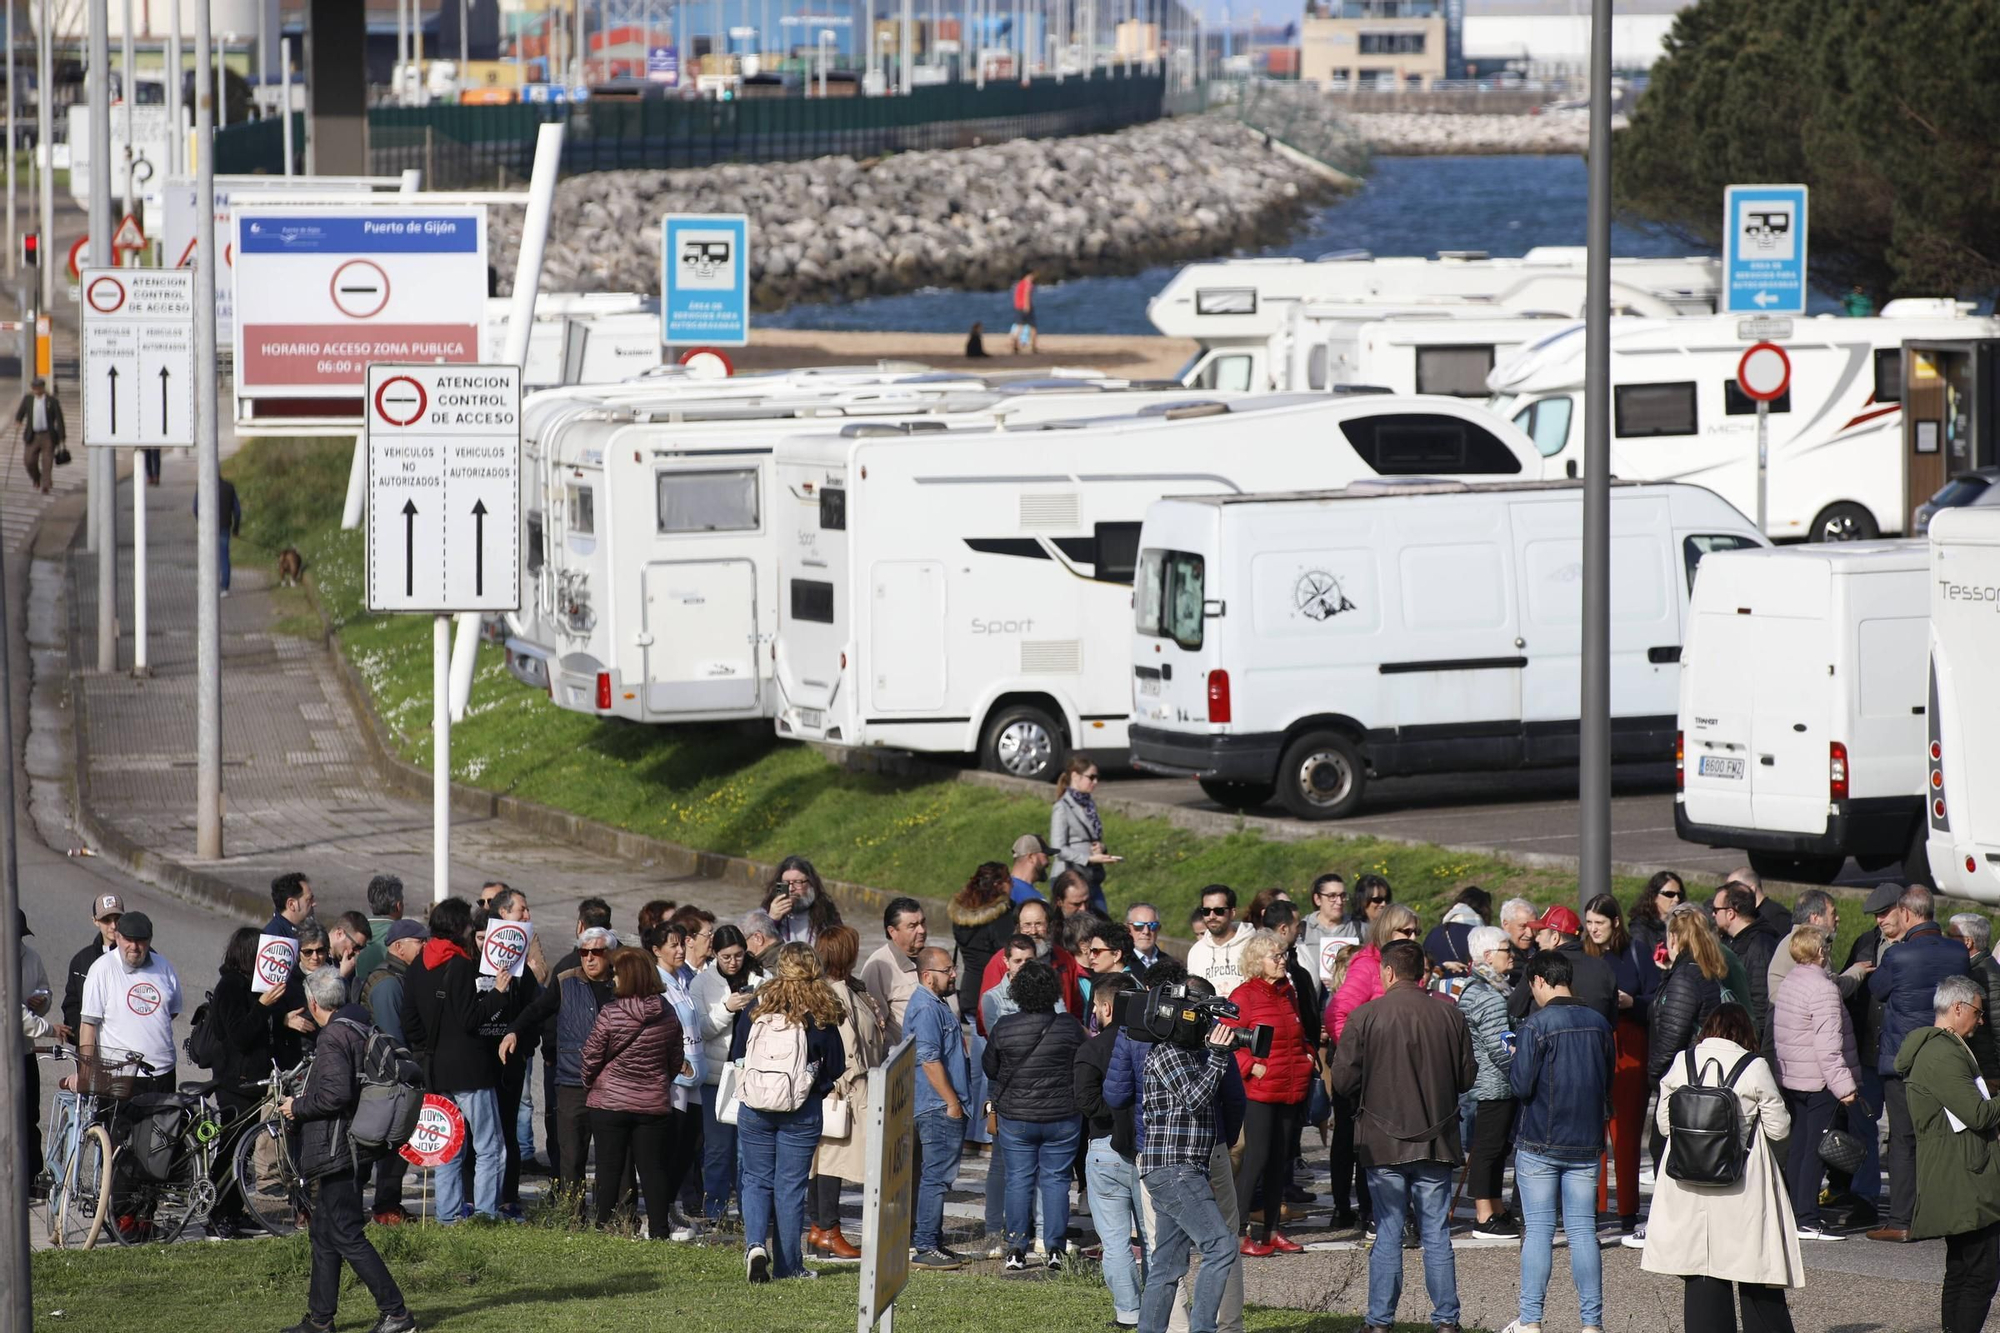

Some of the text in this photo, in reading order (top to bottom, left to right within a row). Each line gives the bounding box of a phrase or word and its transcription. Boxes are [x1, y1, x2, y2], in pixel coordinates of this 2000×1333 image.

[364, 220, 456, 237] Puerto de Gijón
[132, 277, 187, 287] ATENCION
[133, 290, 185, 300] CONTROL
[128, 303, 190, 313] DE ACCESO
[261, 342, 464, 356] HORARIO ACCESO ZONA PUBLICA
[317, 360, 352, 373] 06:00
[354, 363, 362, 373] a
[436, 377, 510, 388] ATENCION
[438, 394, 508, 406] CONTROL
[432, 412, 514, 424] DE ACCESO
[384, 446, 435, 458] VEHICULOS
[455, 446, 505, 458] VEHICULOS
[402, 462, 416, 472] NO
[449, 467, 511, 478] AUTORIZADOS
[379, 476, 440, 487] AUTORIZADOS
[971, 617, 1035, 637] Sport
[414, 1142, 441, 1152] JOVE
